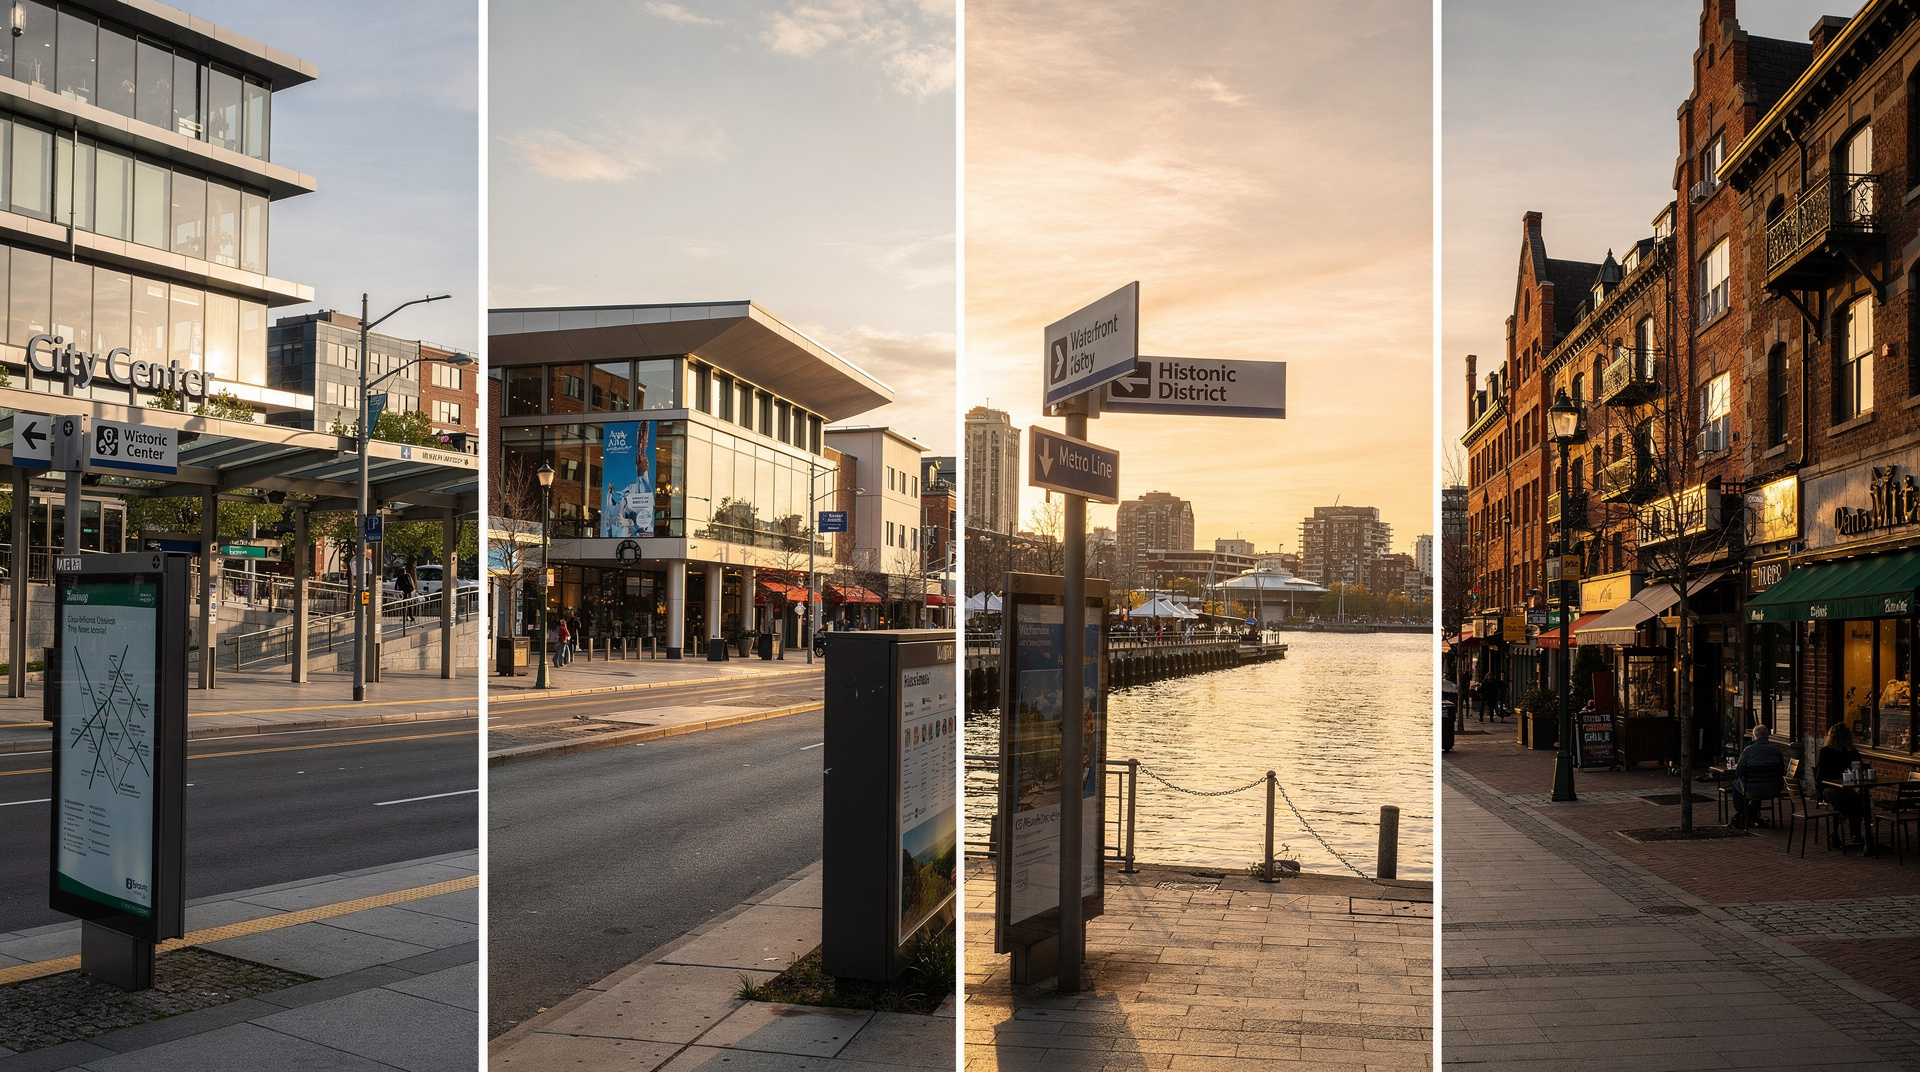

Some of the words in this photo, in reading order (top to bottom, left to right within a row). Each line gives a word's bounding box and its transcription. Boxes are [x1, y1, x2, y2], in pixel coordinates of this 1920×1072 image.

[1070, 314, 1118, 351] Waterfront
[28, 334, 100, 389] City
[106, 347, 215, 398] Center
[1158, 382, 1227, 402] District
[124, 429, 168, 446] Wistoric
[126, 444, 165, 460] Center
[1059, 445, 1089, 472] Metro
[1091, 454, 1112, 478] Line
